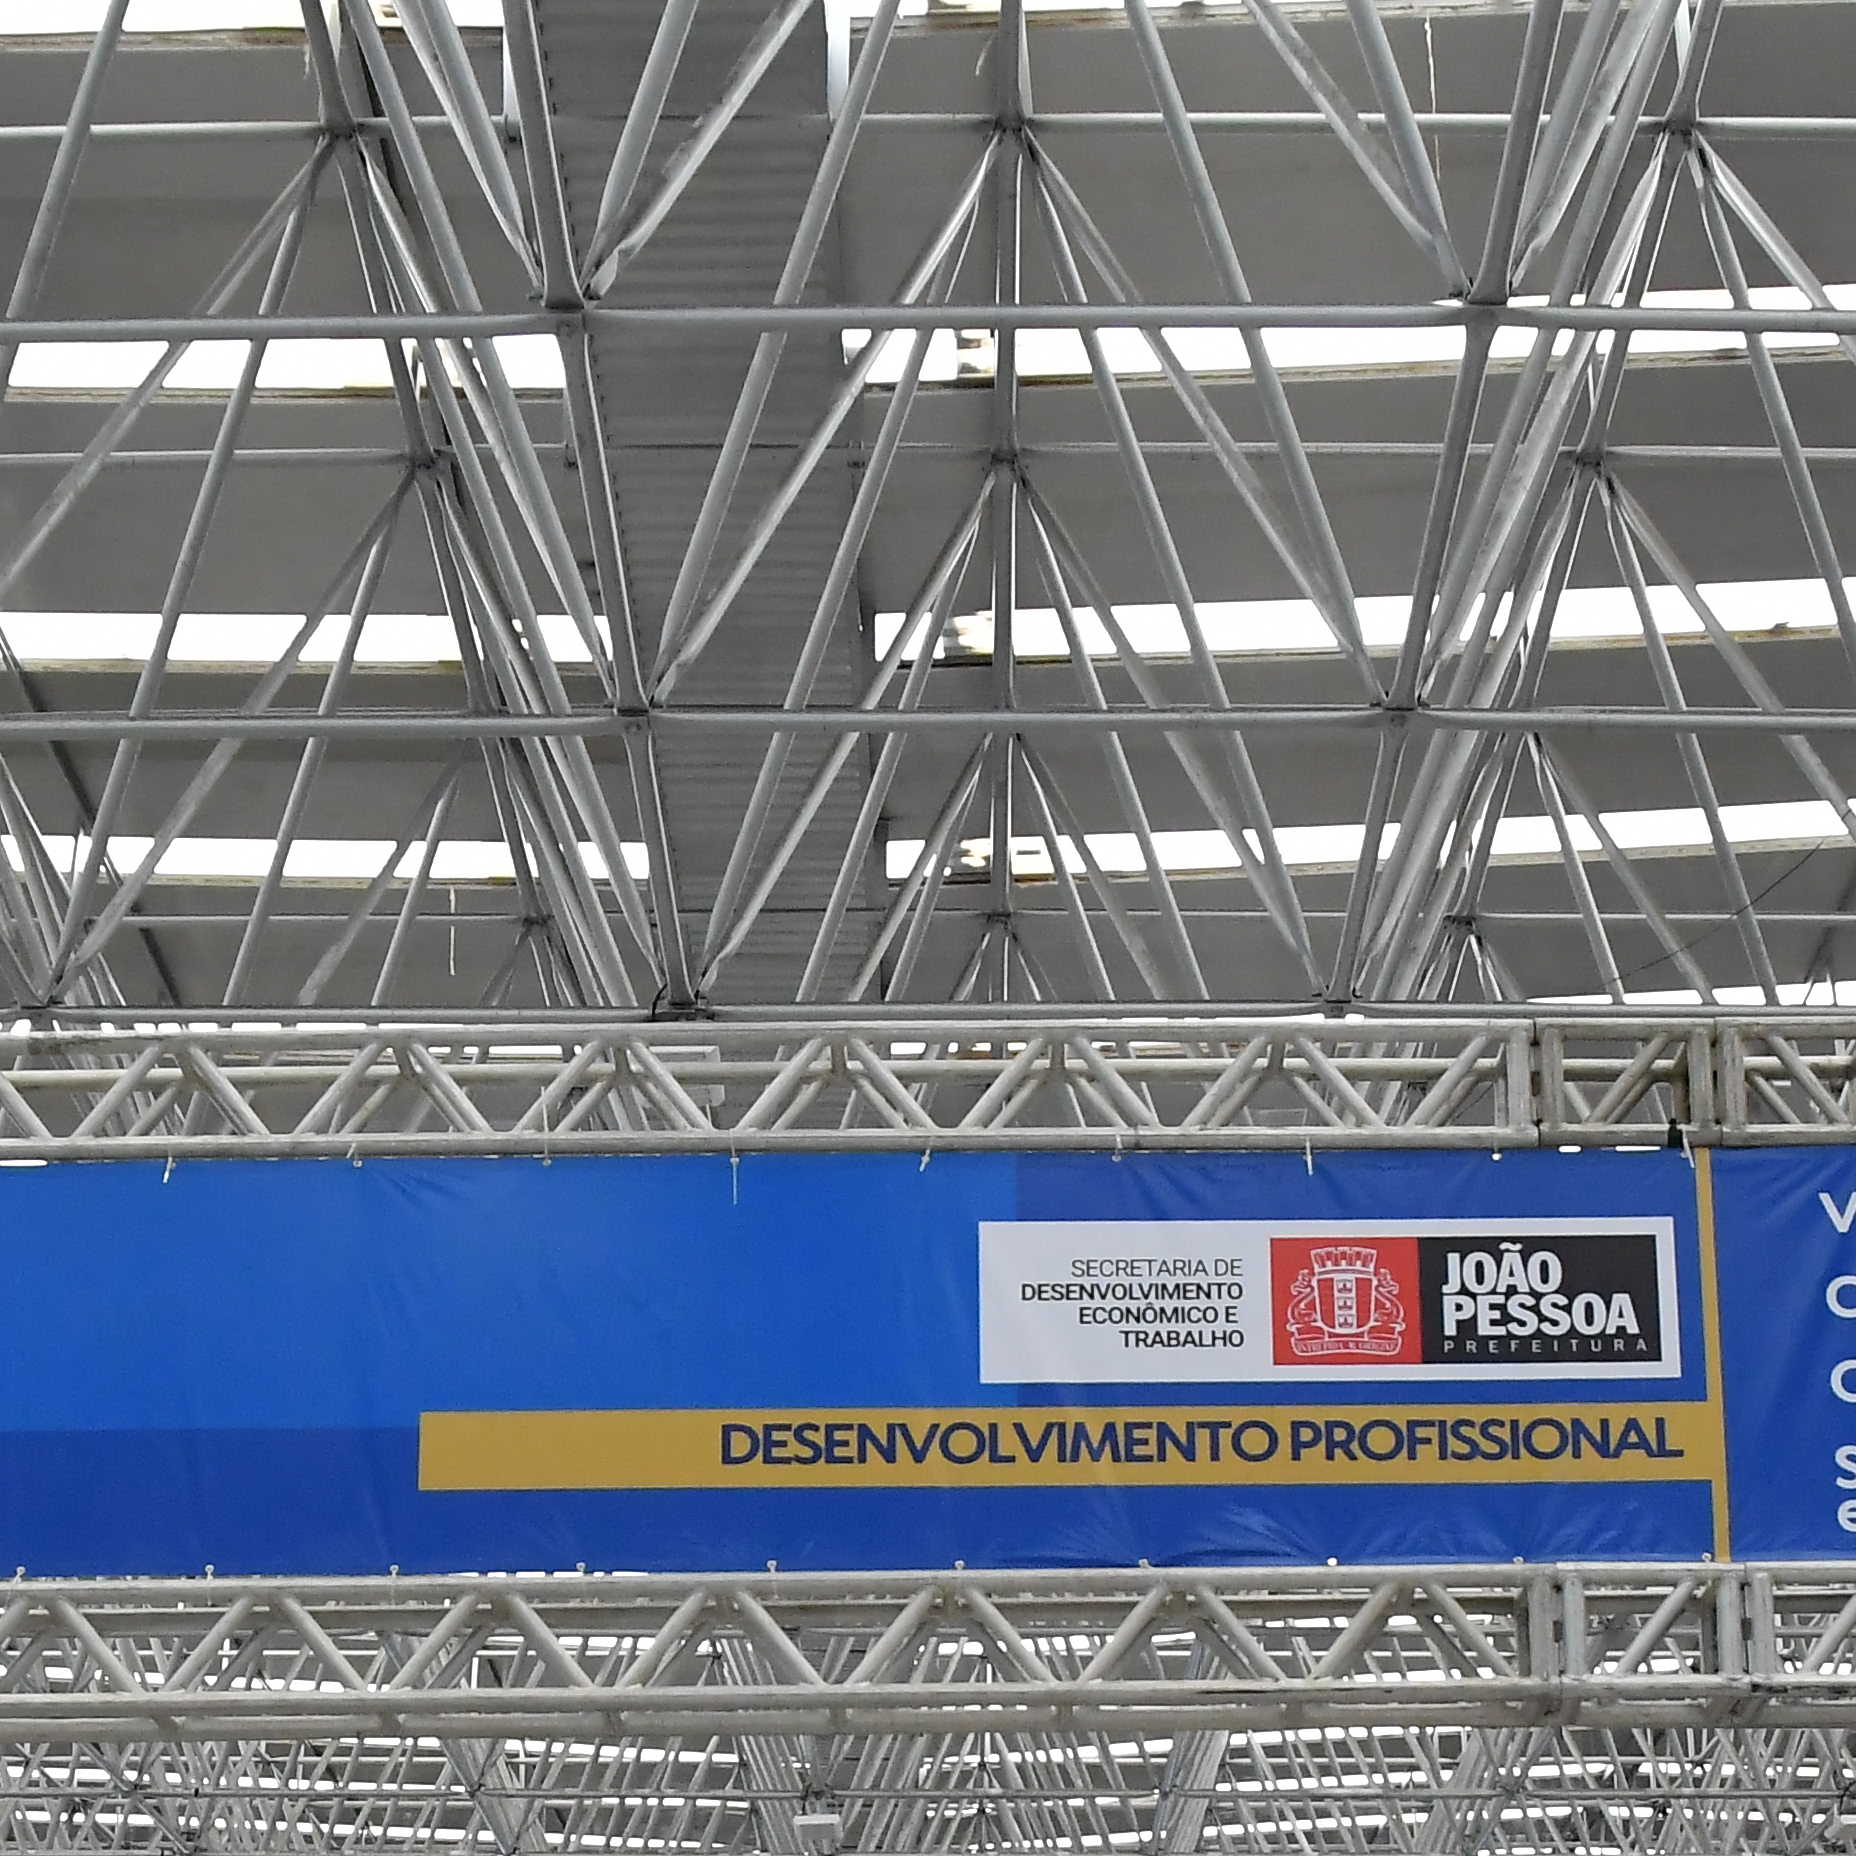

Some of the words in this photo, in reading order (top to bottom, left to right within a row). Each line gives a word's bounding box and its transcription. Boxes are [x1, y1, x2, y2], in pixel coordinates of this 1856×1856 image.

[1071, 1257, 1216, 1278] SECRETARIA
[1220, 1257, 1244, 1277] DE
[1442, 1242, 1562, 1295] JOÃO
[1021, 1282, 1244, 1302] DESENVOLVIMENTO
[1078, 1303, 1224, 1325] ECONÔMICO
[1228, 1306, 1239, 1324] E
[1443, 1293, 1640, 1336] PESSOA
[1120, 1328, 1245, 1349] TRABALHO
[1443, 1337, 1649, 1354] PREFEITURA
[719, 1421, 1279, 1467] DESENVOLVIMENTO
[1290, 1417, 1684, 1462] PROFISSIONAL
